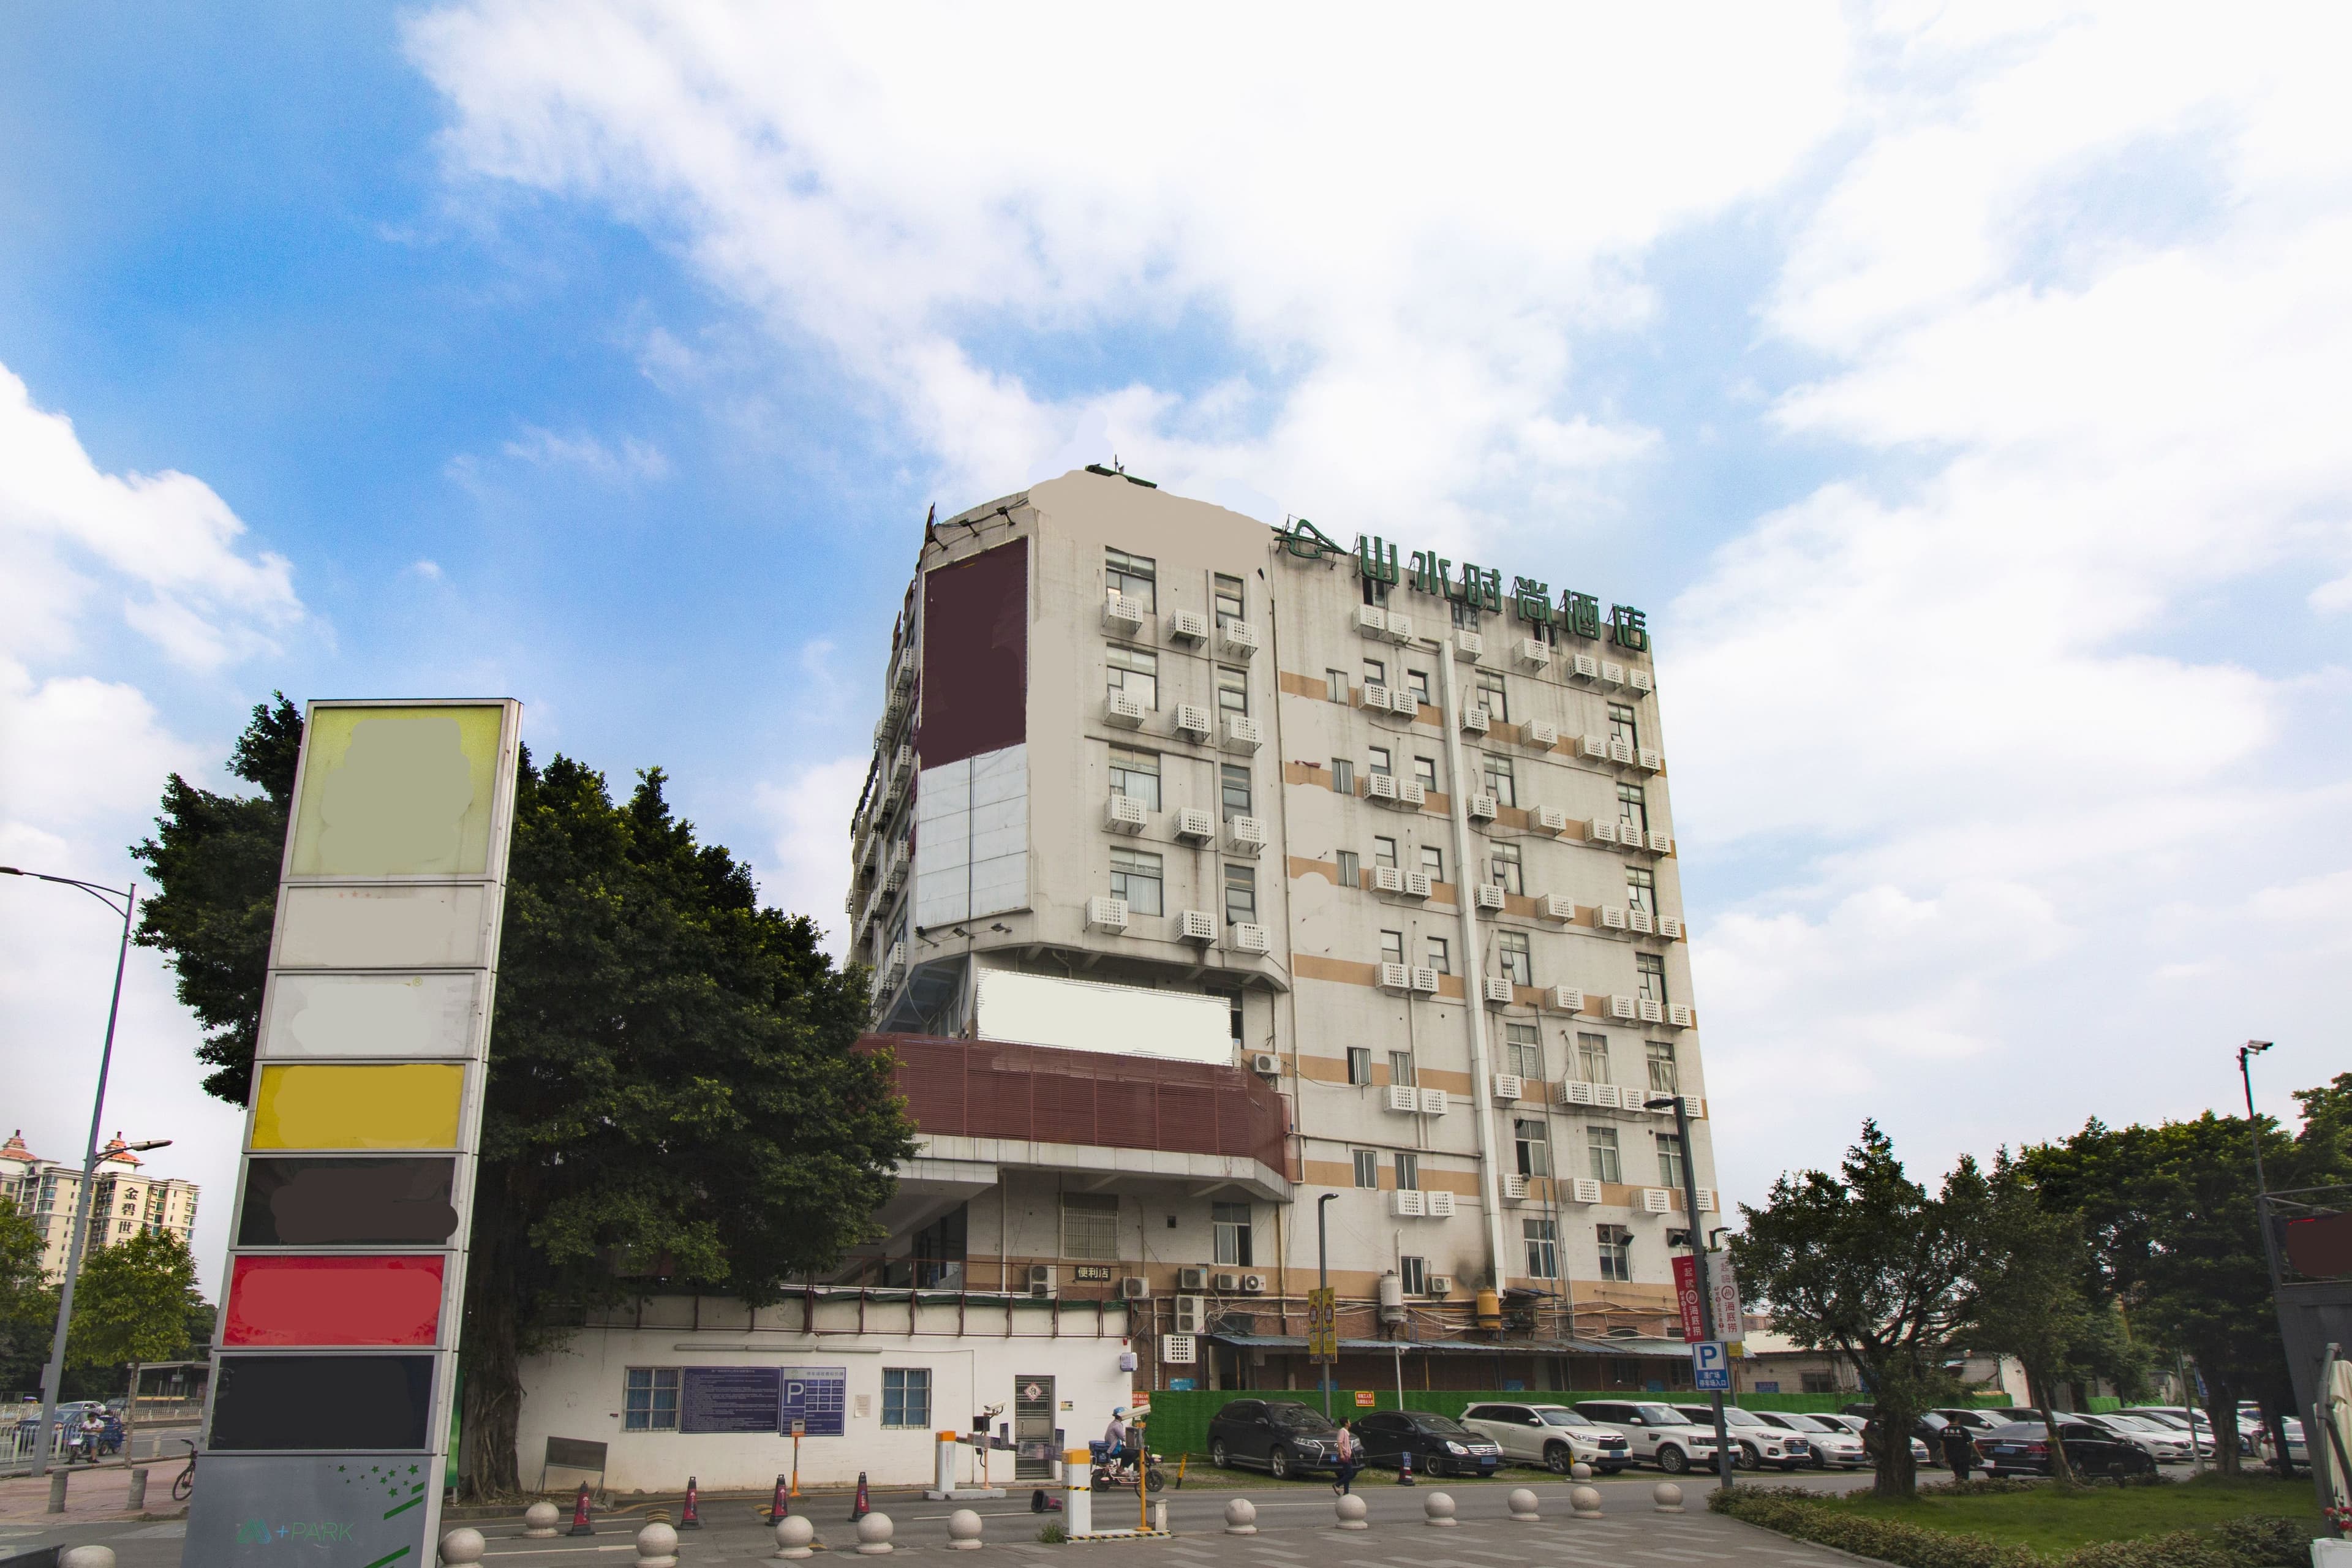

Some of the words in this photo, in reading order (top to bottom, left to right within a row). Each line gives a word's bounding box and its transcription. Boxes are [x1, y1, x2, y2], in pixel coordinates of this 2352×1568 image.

[1359, 535, 1648, 652] 山水时尚酒店
[1078, 1267, 1109, 1278] 便利店
[1689, 1305, 1702, 1336] 海底捞
[1725, 1302, 1738, 1333] 海底捞
[1699, 1345, 1717, 1368] P
[787, 1382, 804, 1404] P
